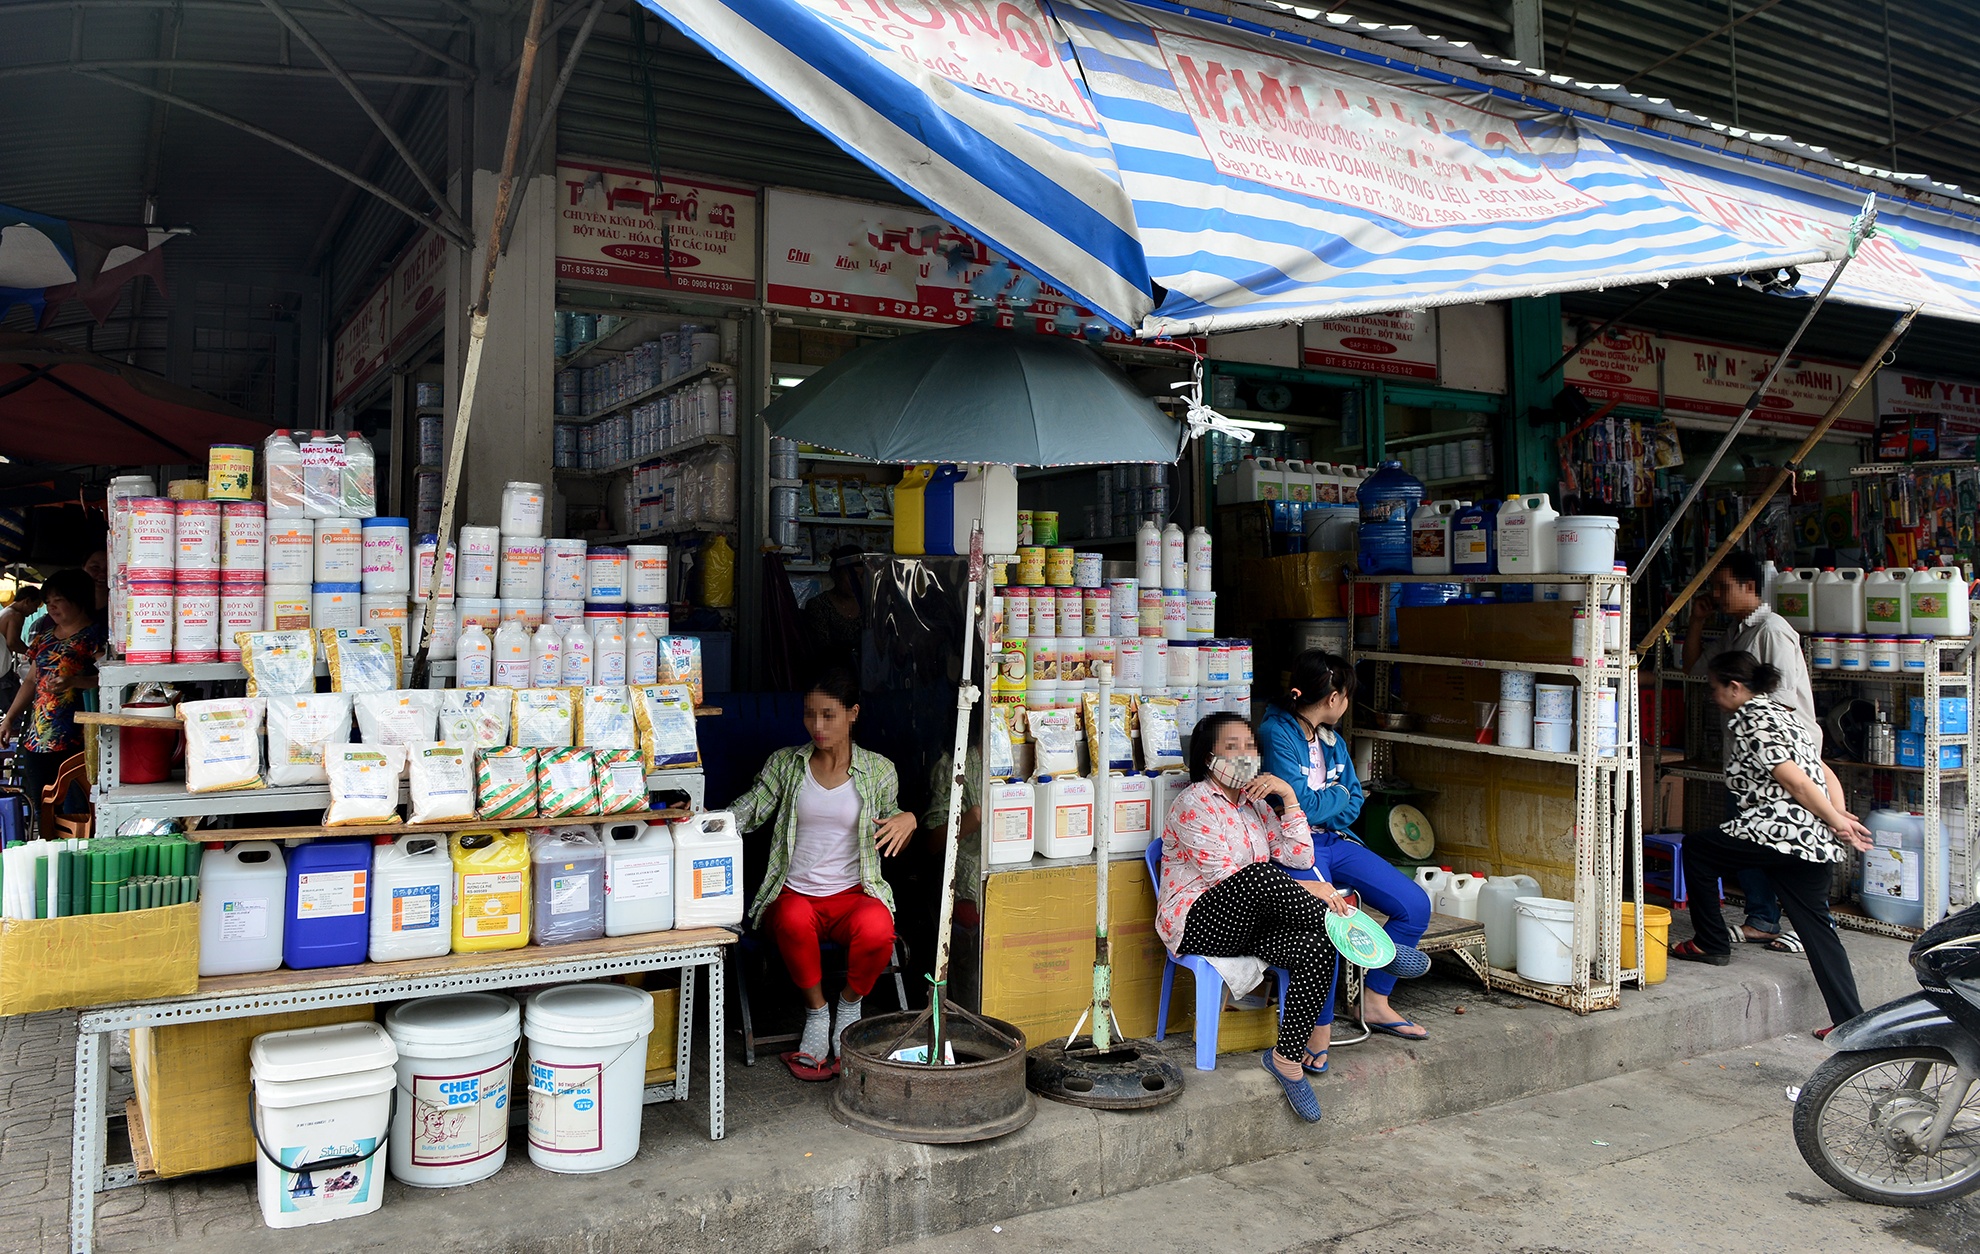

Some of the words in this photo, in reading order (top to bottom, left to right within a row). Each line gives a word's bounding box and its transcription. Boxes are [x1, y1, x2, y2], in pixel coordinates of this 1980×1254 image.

[1219, 130, 1289, 162] CHUYÊN
[1287, 144, 1330, 170] KINH
[1330, 152, 1385, 184] DOANH
[1385, 165, 1435, 200] HƯƠNG
[1434, 182, 1471, 208] LIỆU
[1478, 188, 1515, 207] BỘT
[1514, 185, 1556, 203] MÀU
[1218, 152, 1251, 177] Sạp
[1250, 162, 1272, 181] 23
[1286, 171, 1307, 188] 24
[1343, 183, 1361, 202] 19
[1391, 194, 1467, 223] 38.592.590
[1477, 196, 1589, 220] 0903.709.504
[563, 210, 607, 224] CHUYÊN
[573, 225, 594, 240] BỘT
[597, 227, 620, 239] MÀU
[629, 231, 653, 244] HÓA
[682, 238, 701, 250] CÁC
[704, 243, 727, 254] LOẠI
[638, 251, 650, 259] 25
[677, 256, 688, 265] 19
[562, 264, 574, 273] ĐT:
[575, 265, 581, 274] 8
[581, 266, 594, 276] 536
[595, 268, 609, 277] 328
[692, 278, 707, 288] 0908
[708, 280, 719, 290] 412
[721, 281, 732, 291] 334
[1322, 322, 1351, 333] HƯƠNG
[1353, 327, 1372, 337] LIỆU
[1378, 330, 1394, 340] BỘT
[1341, 359, 1347, 367] 8
[1347, 360, 1361, 369] 577
[1362, 362, 1375, 370] 214
[1380, 364, 1386, 372] 9
[1387, 364, 1400, 374] 523
[1401, 366, 1413, 376] 142
[1627, 364, 1639, 373] TAY
[1924, 984, 1953, 995] HONDA
[530, 1063, 554, 1080] CHEF
[439, 1078, 479, 1094] CHEF
[534, 1077, 554, 1093] BOS
[448, 1090, 479, 1106] BOS
[321, 1143, 361, 1156] SunField
